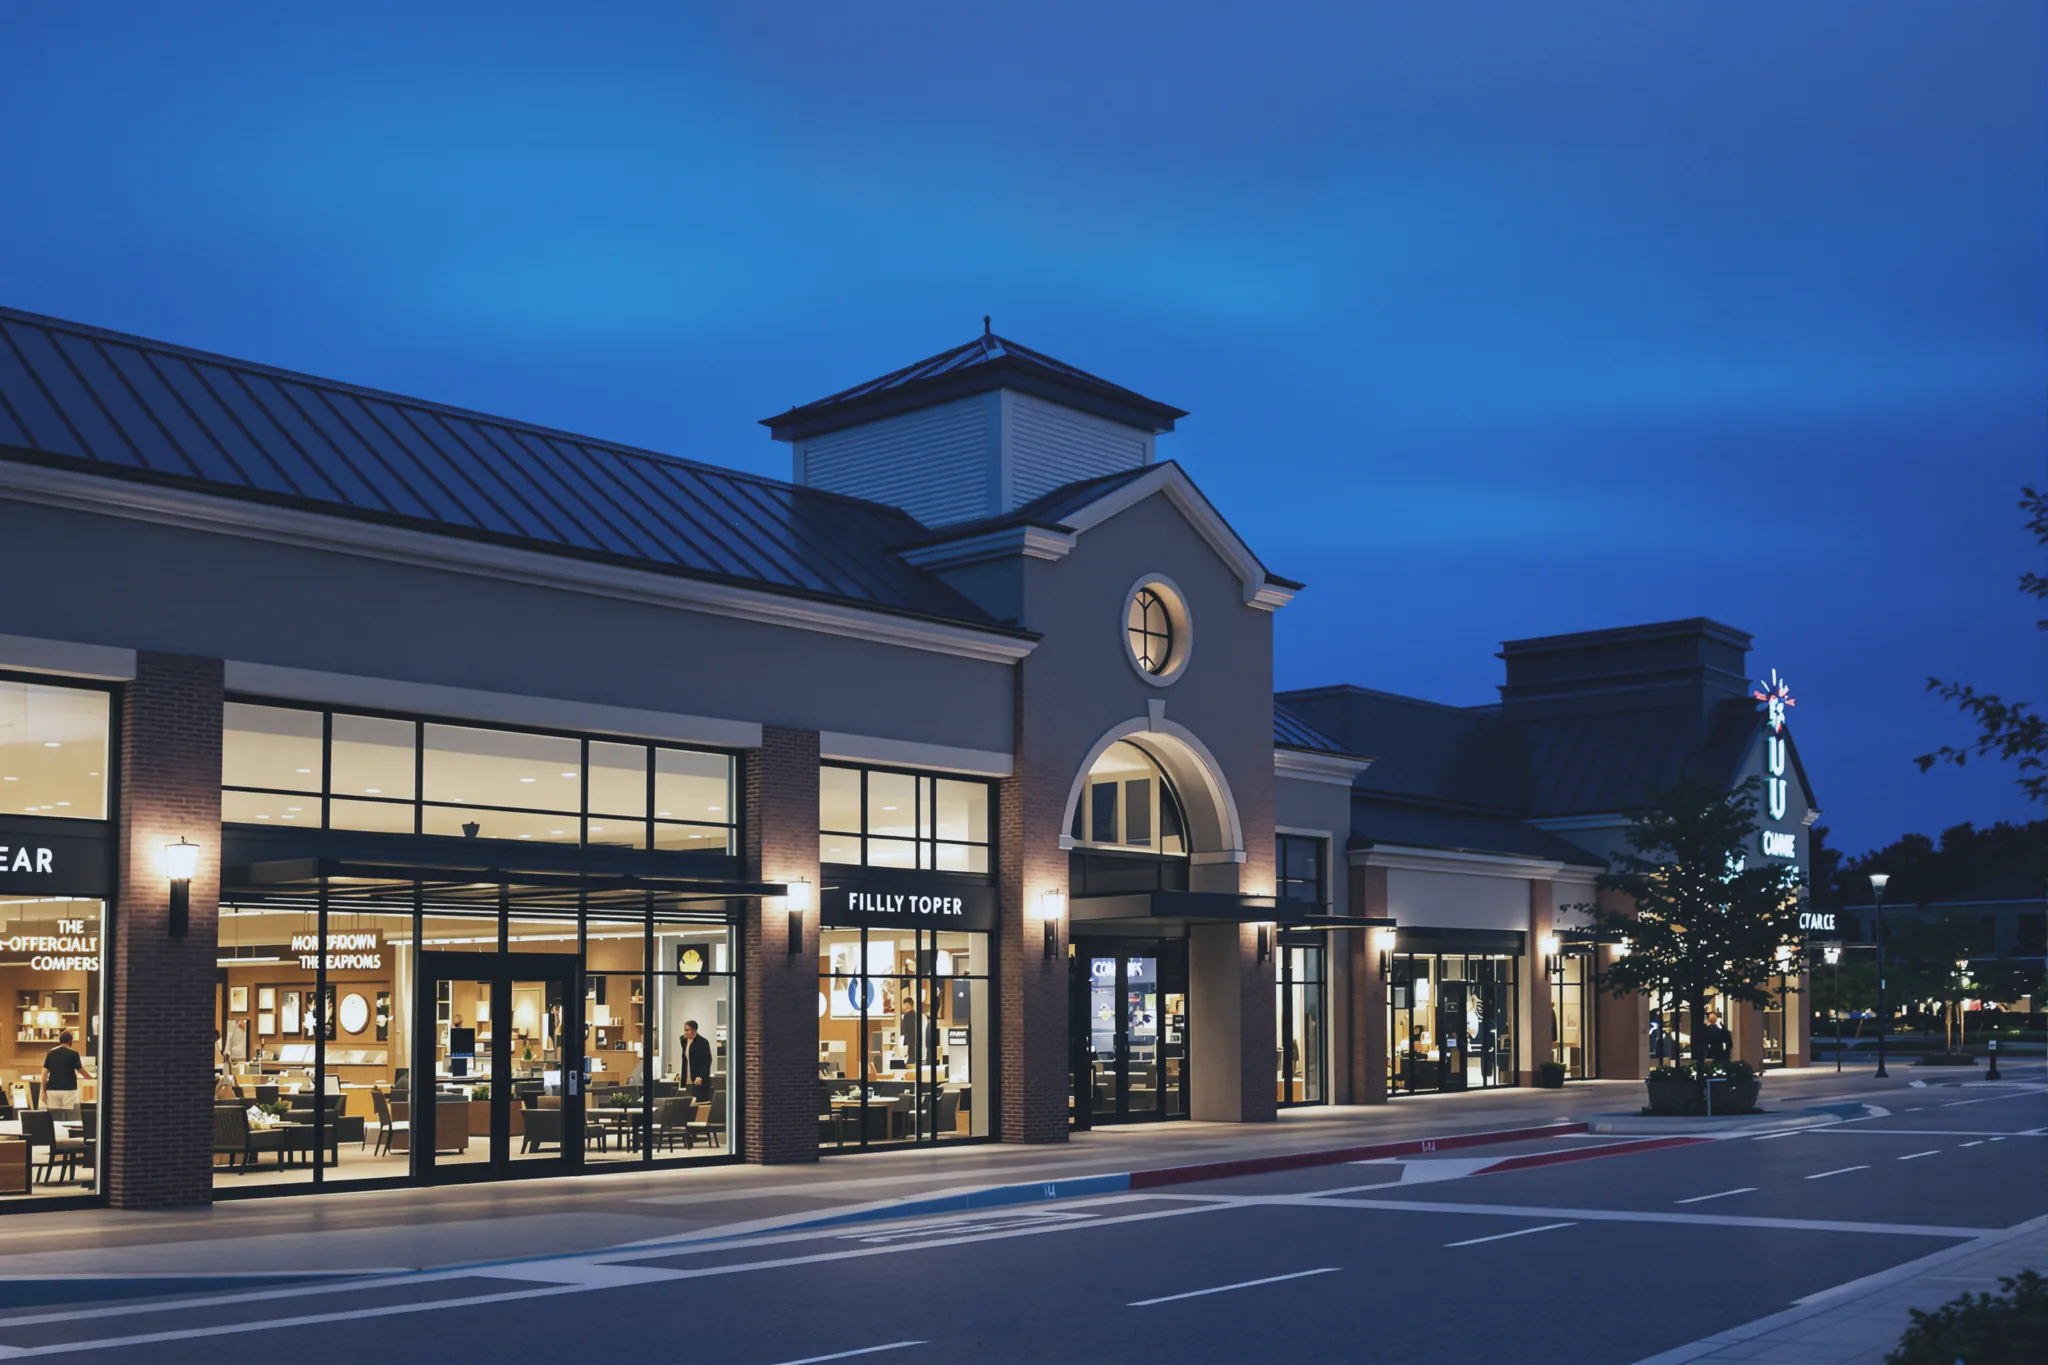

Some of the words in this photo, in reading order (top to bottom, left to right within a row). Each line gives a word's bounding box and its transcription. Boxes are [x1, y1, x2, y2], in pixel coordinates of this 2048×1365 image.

[0, 846, 53, 873] EAR
[849, 892, 904, 912] FILLLY
[909, 896, 962, 915] TOPER
[57, 919, 85, 934] THE
[30, 956, 99, 971] COMPERS
